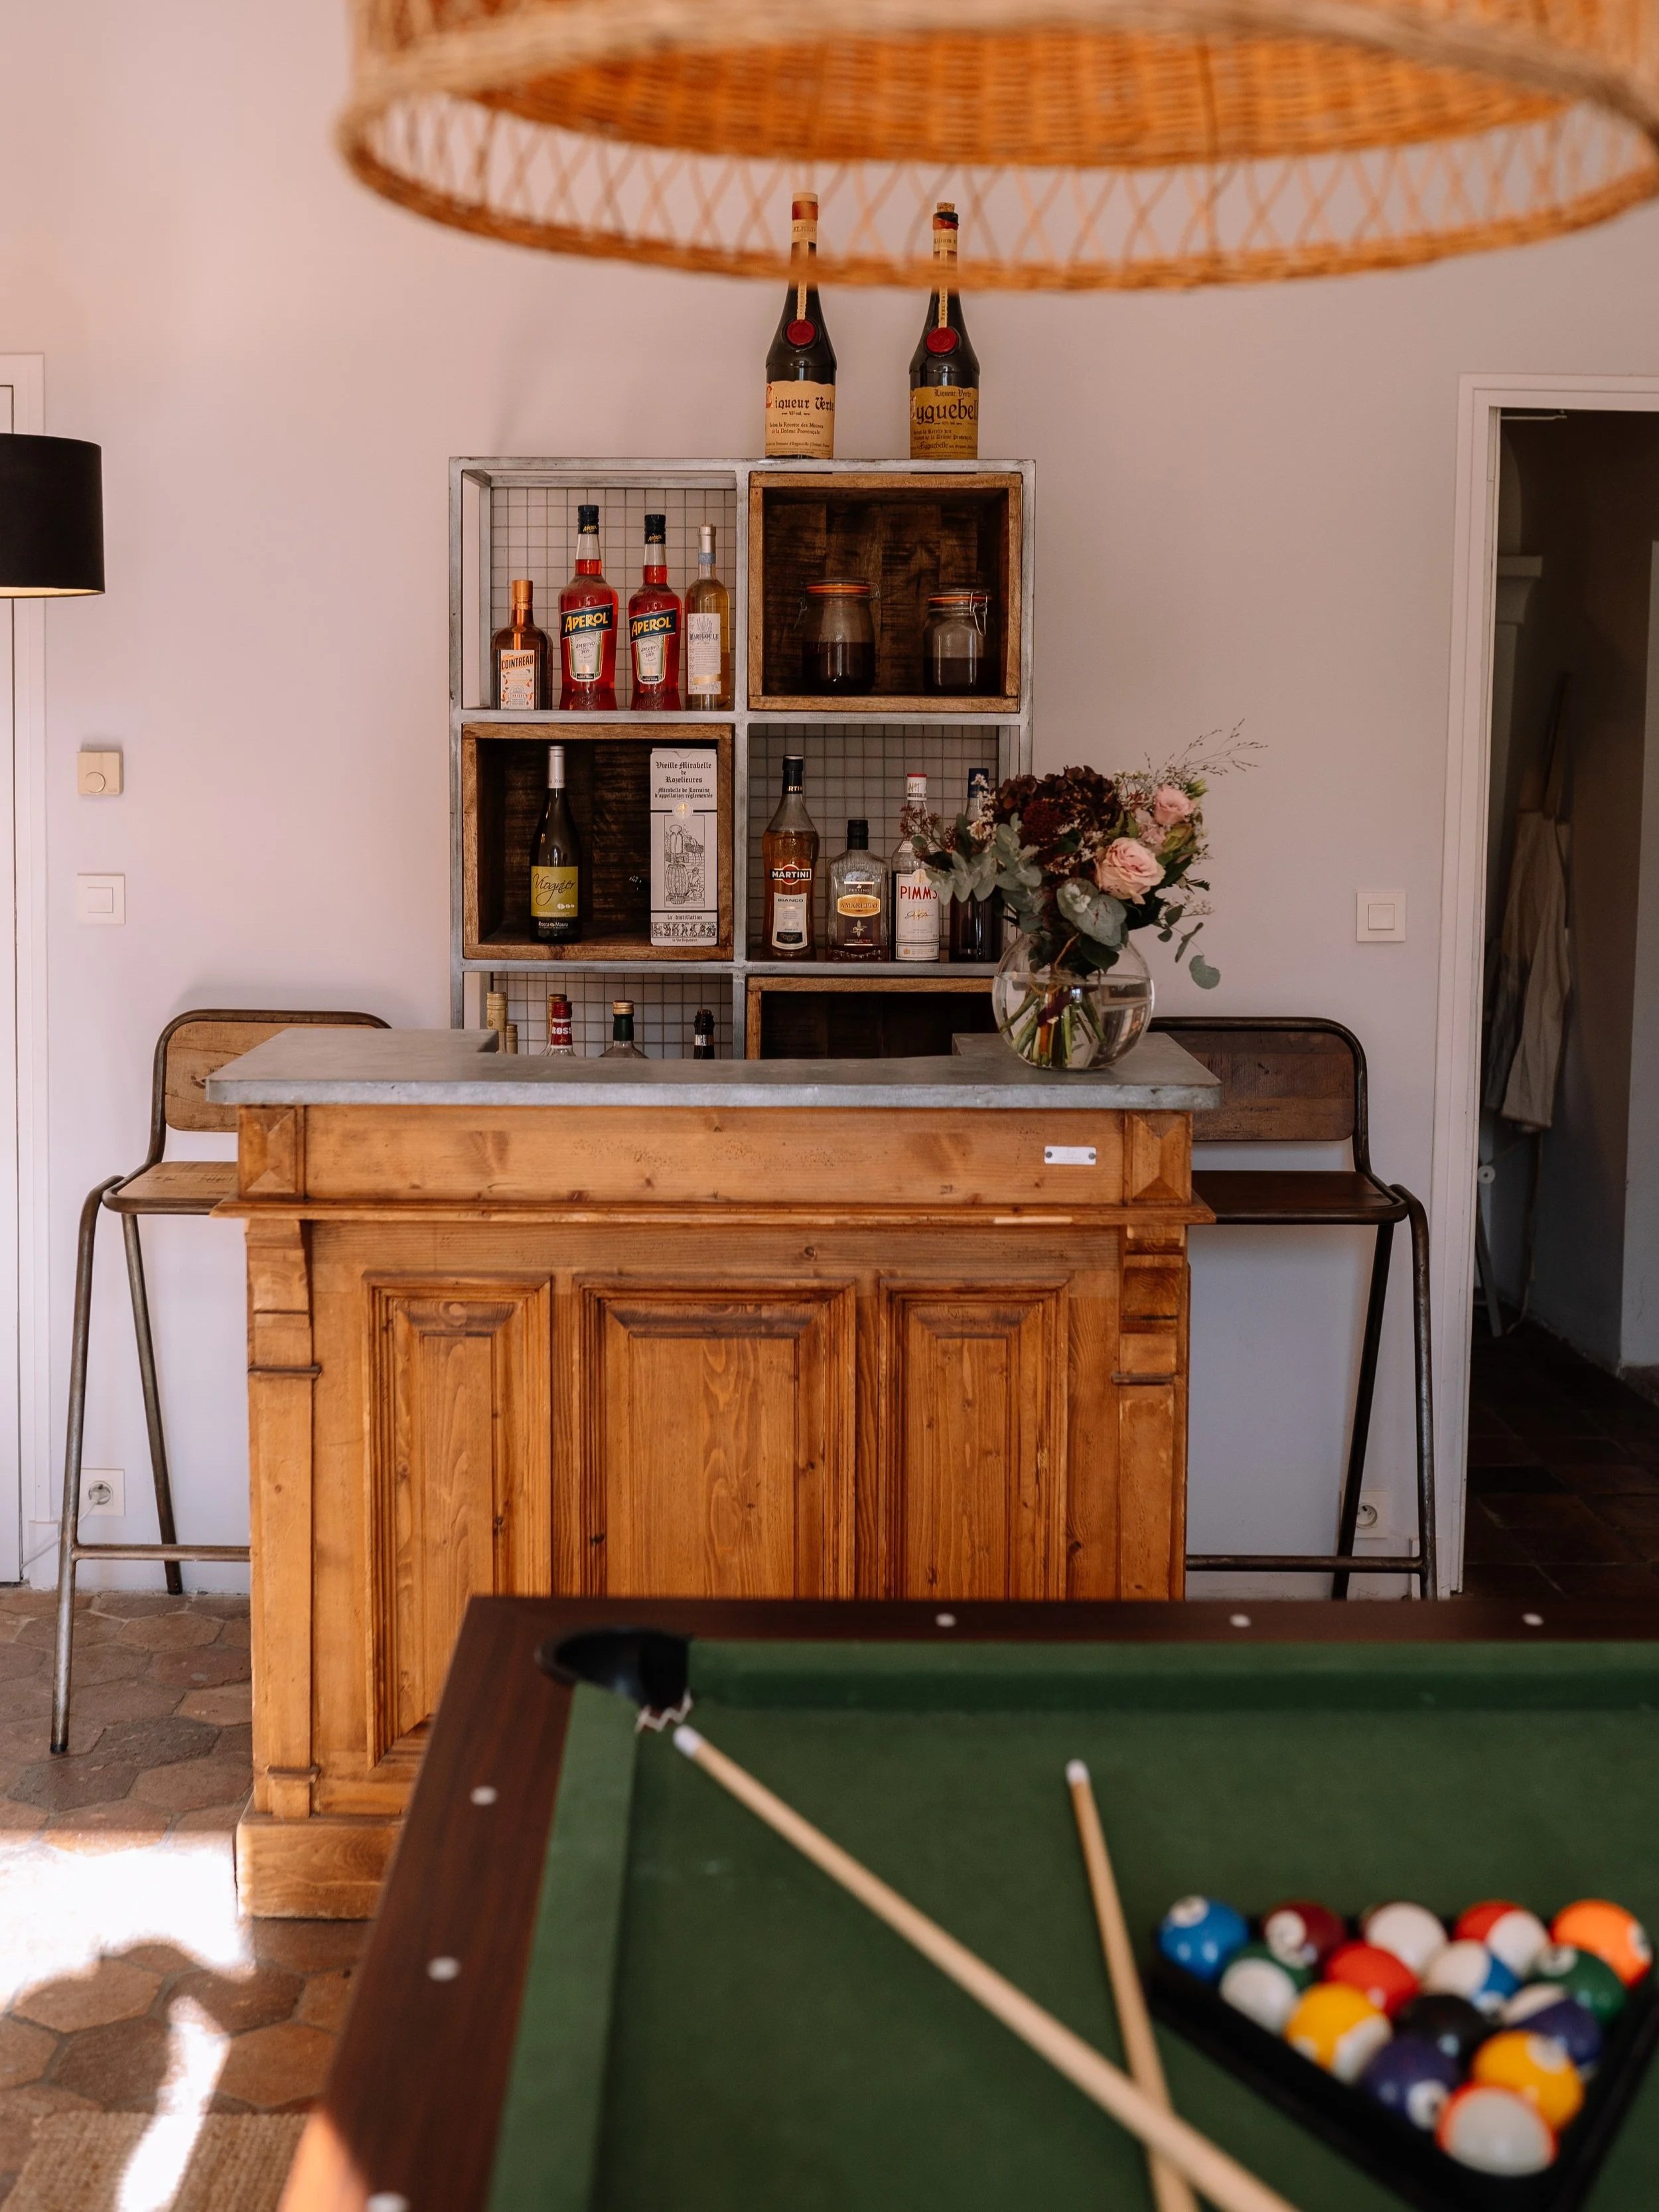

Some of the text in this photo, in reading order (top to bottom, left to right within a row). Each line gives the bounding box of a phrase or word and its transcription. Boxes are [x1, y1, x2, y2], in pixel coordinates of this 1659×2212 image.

[934, 389, 956, 398] Liqueur
[815, 396, 834, 411] Verte
[565, 612, 608, 632] APEROL
[632, 617, 672, 637] APEROL
[502, 654, 534, 670] COINTREAU
[533, 873, 577, 907] Viognier
